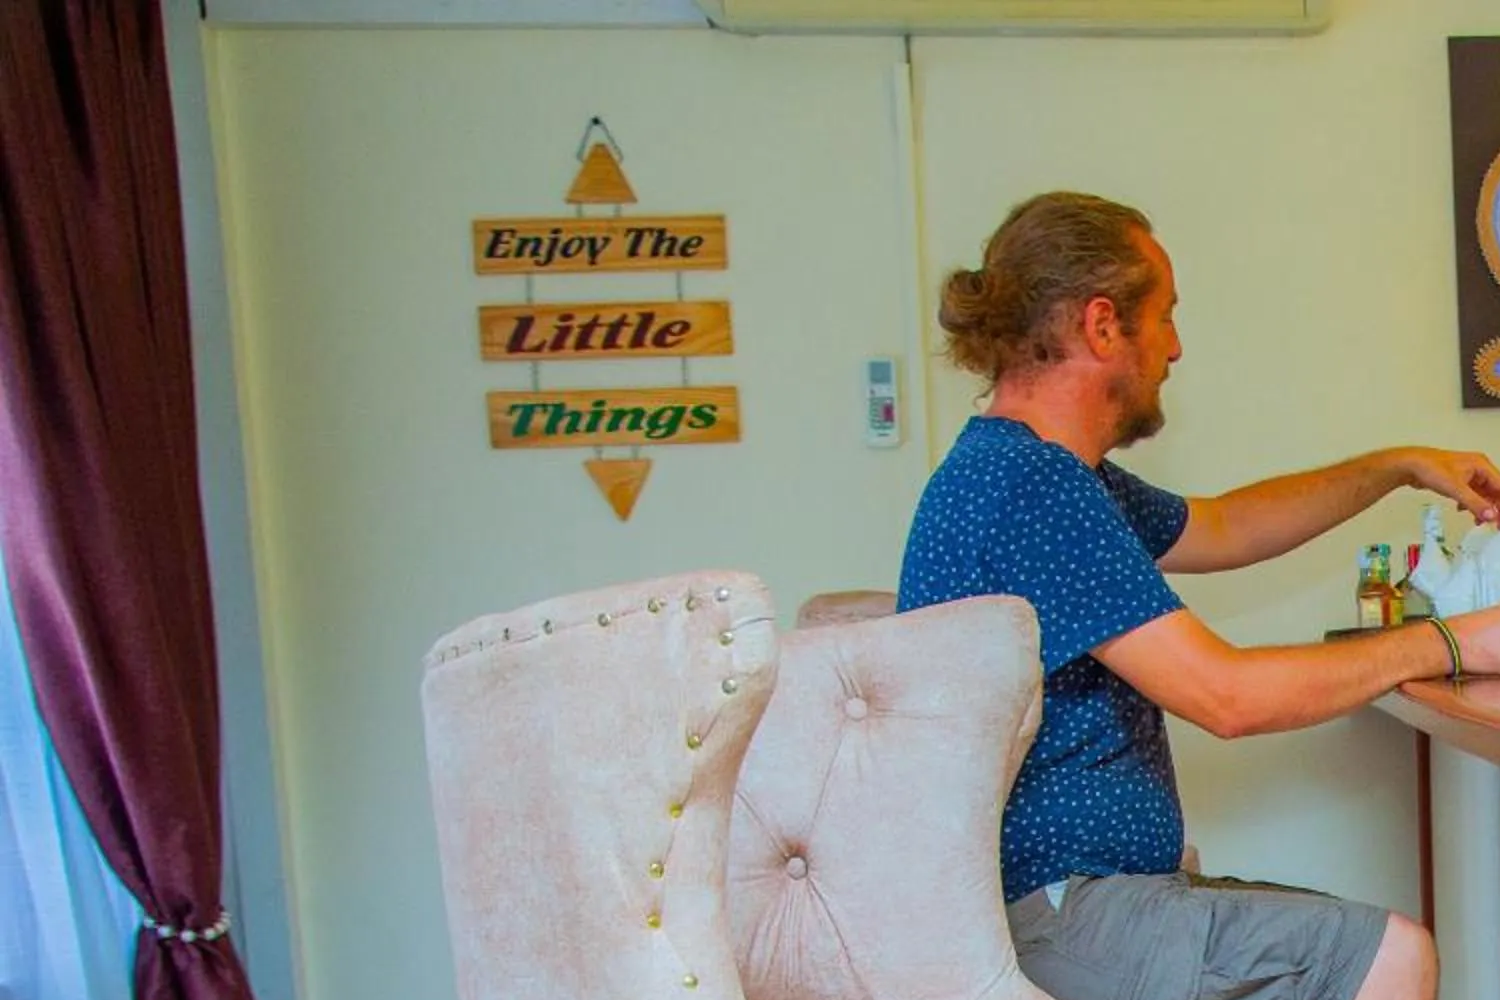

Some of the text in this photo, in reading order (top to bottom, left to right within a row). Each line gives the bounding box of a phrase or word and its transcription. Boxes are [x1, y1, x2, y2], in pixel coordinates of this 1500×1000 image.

[484, 227, 705, 266] Enjoy The
[505, 311, 692, 354] Little
[508, 399, 719, 440] Things
